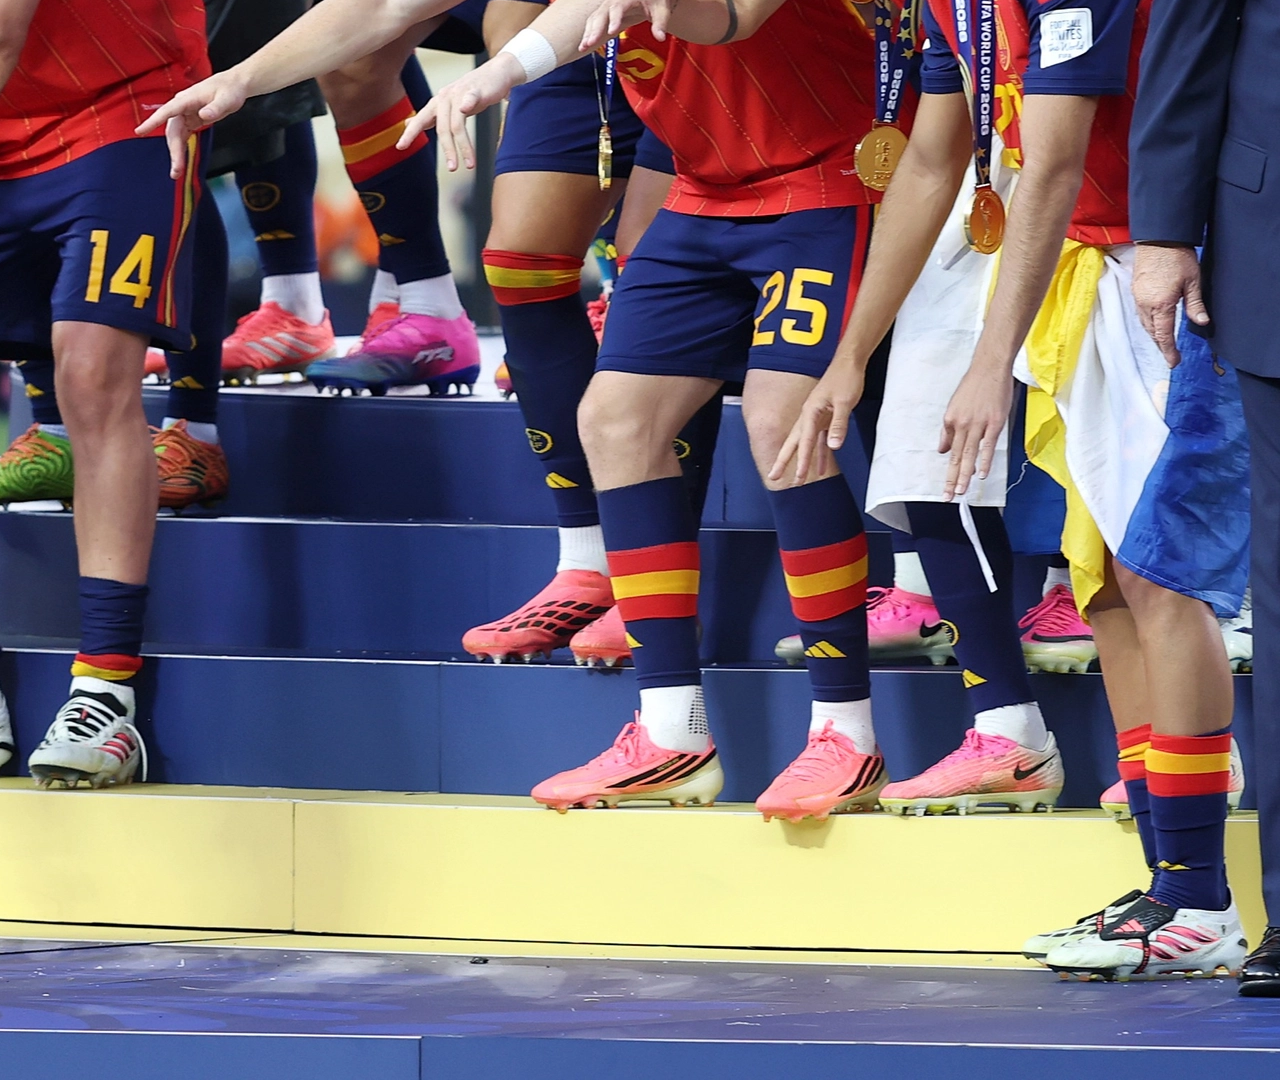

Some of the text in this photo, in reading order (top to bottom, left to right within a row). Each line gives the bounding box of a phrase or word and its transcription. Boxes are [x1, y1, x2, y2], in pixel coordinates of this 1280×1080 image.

[955, 0, 968, 43] 2026
[980, 19, 992, 65] WORLD
[605, 60, 614, 85] FIFA
[879, 40, 889, 83] 2026
[980, 66, 991, 91] CUP
[886, 69, 903, 110] 2026
[980, 92, 991, 136] 2026
[84, 230, 155, 309] 14
[751, 267, 834, 347] 25
